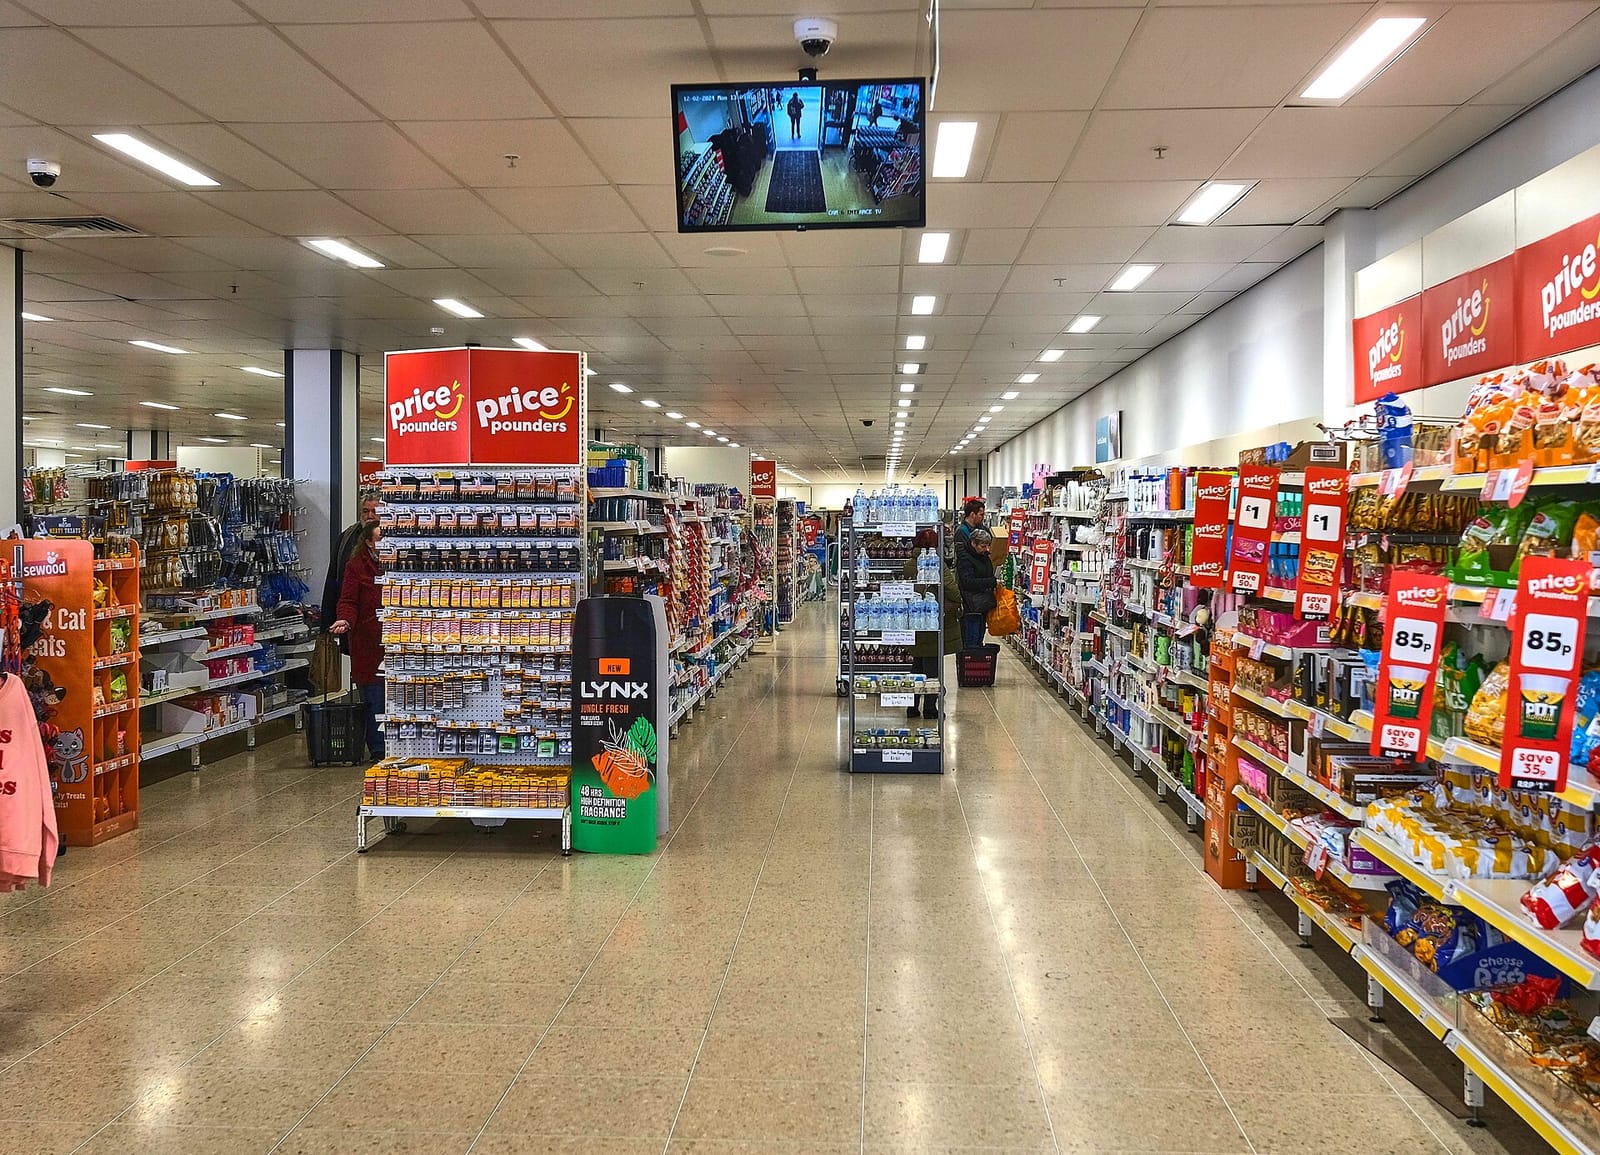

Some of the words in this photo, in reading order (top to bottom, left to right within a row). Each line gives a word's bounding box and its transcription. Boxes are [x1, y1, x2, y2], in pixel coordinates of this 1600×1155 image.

[1541, 243, 1597, 329] price
[1441, 289, 1483, 359] price
[1550, 302, 1600, 338] pounders
[1368, 321, 1400, 381] price
[1448, 337, 1487, 367] pounders
[1373, 364, 1402, 387] pounders
[389, 386, 451, 430] price
[475, 386, 559, 428] price
[399, 419, 458, 436] pounders
[491, 419, 567, 435] pounders
[1243, 475, 1270, 486] price
[1308, 478, 1339, 493] price
[1198, 486, 1224, 498] price
[1245, 505, 1260, 520] £1
[1195, 524, 1221, 536] price
[1312, 514, 1329, 531] £1
[1192, 562, 1218, 574] price
[1236, 573, 1257, 581] save
[1528, 575, 1574, 595] price
[1306, 596, 1328, 604] save
[1396, 586, 1436, 603] price
[58, 608, 87, 630] Cat
[1395, 631, 1432, 652] 85p
[1526, 630, 1572, 657] 85p
[607, 664, 622, 673] NEW
[580, 681, 649, 699] LYNX
[580, 704, 604, 713] JUNGLE
[605, 704, 629, 714] FRESH
[1386, 728, 1415, 739] save
[1519, 753, 1554, 764] save
[1523, 763, 1546, 777] 35p
[580, 786, 590, 797] 48
[590, 788, 603, 797] HRS
[593, 798, 626, 807] DEFINITION
[580, 806, 626, 818] FRAGRANCE
